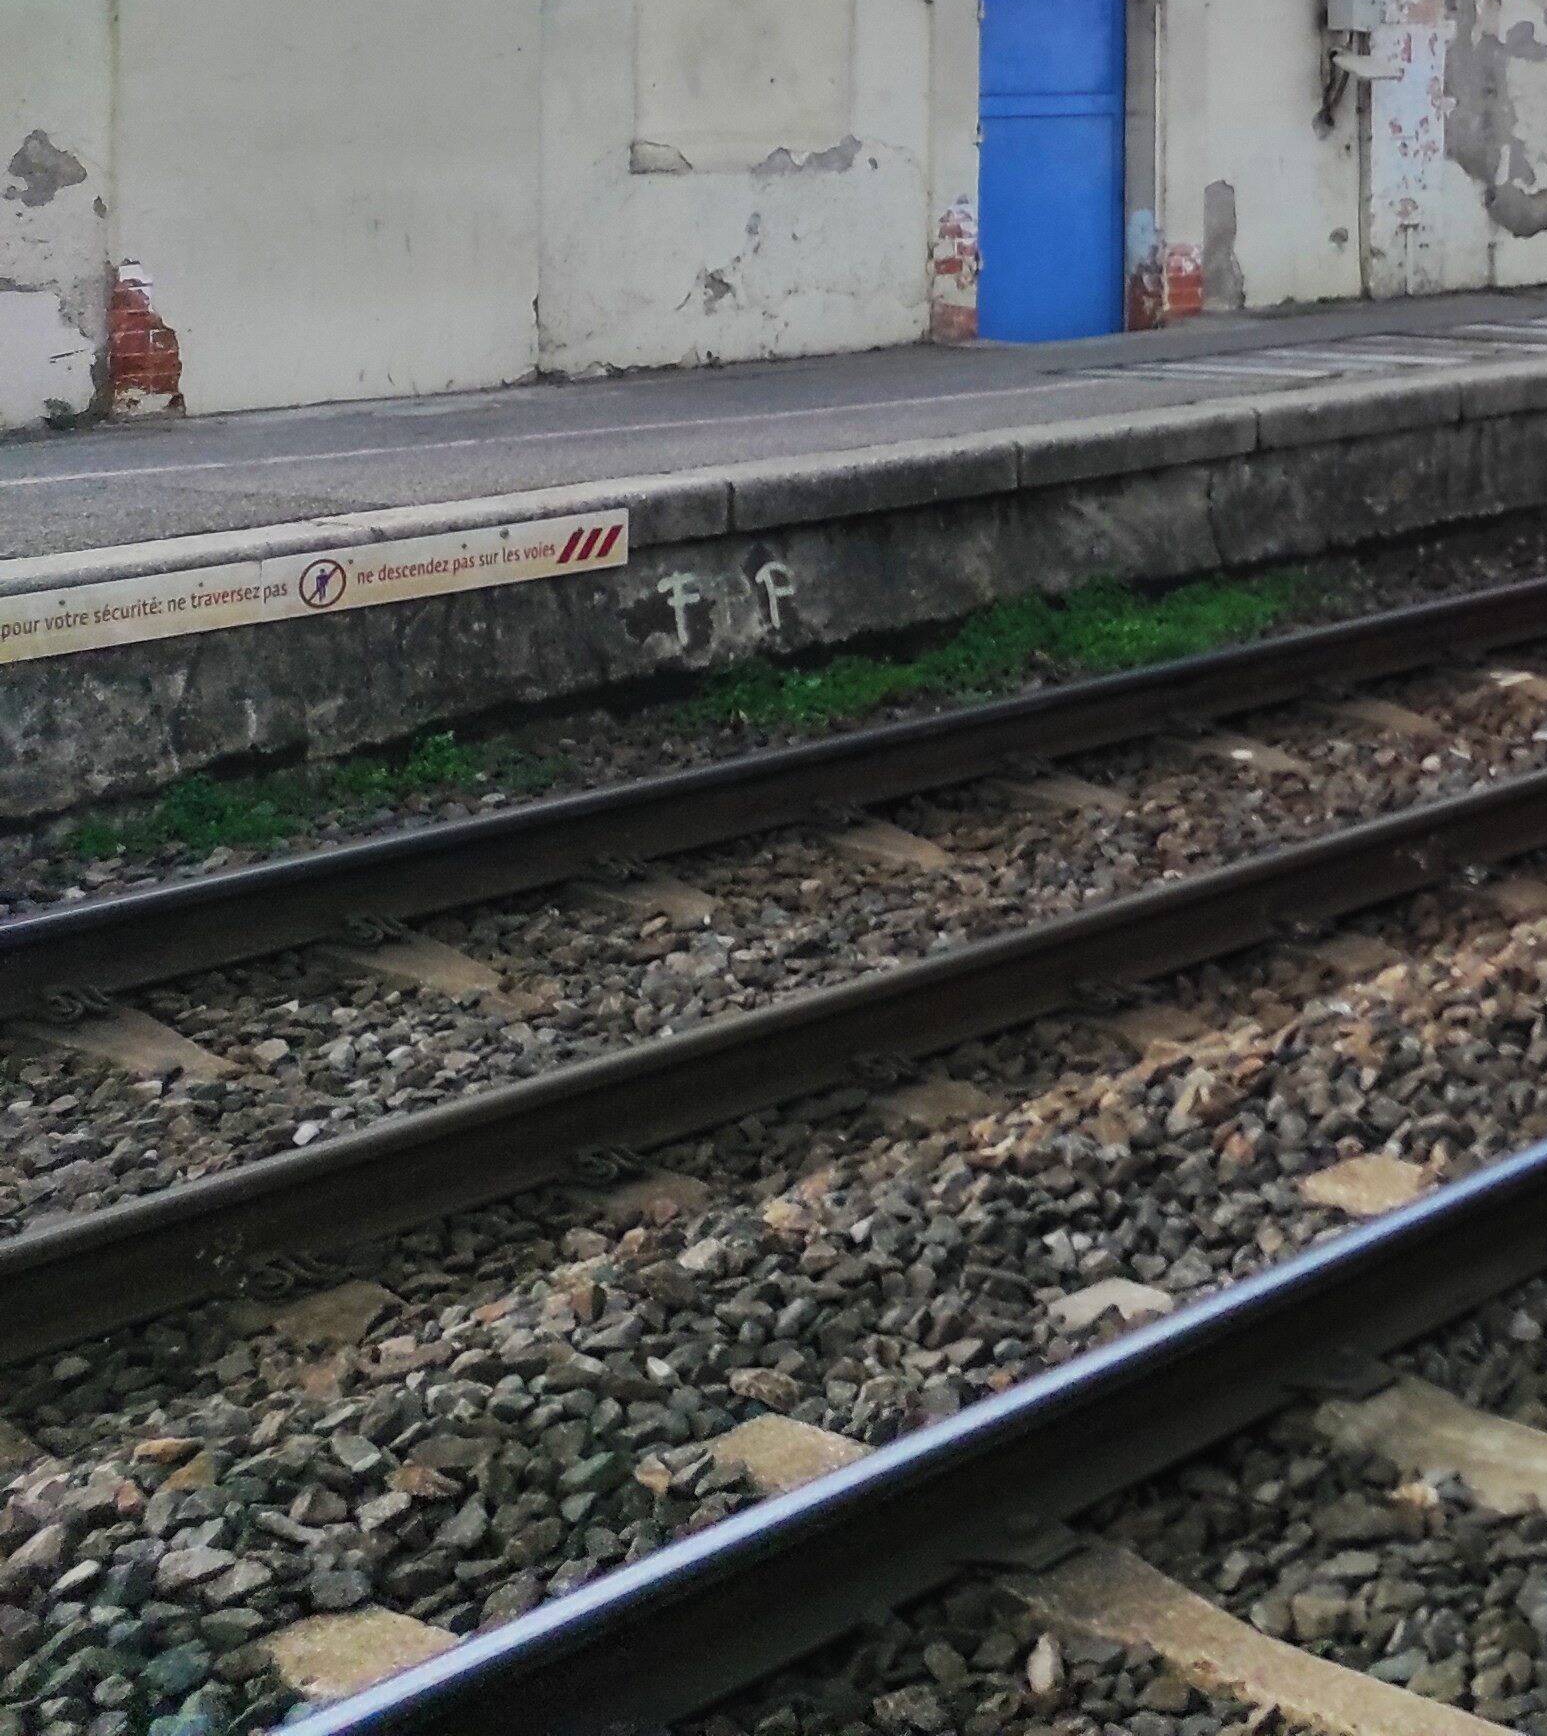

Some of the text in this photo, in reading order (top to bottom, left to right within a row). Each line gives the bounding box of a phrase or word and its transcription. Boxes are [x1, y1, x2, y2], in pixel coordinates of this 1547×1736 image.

[1, 542, 556, 641] pour votre sécurité: ne traversez pas ne descendez pas sur les voies
